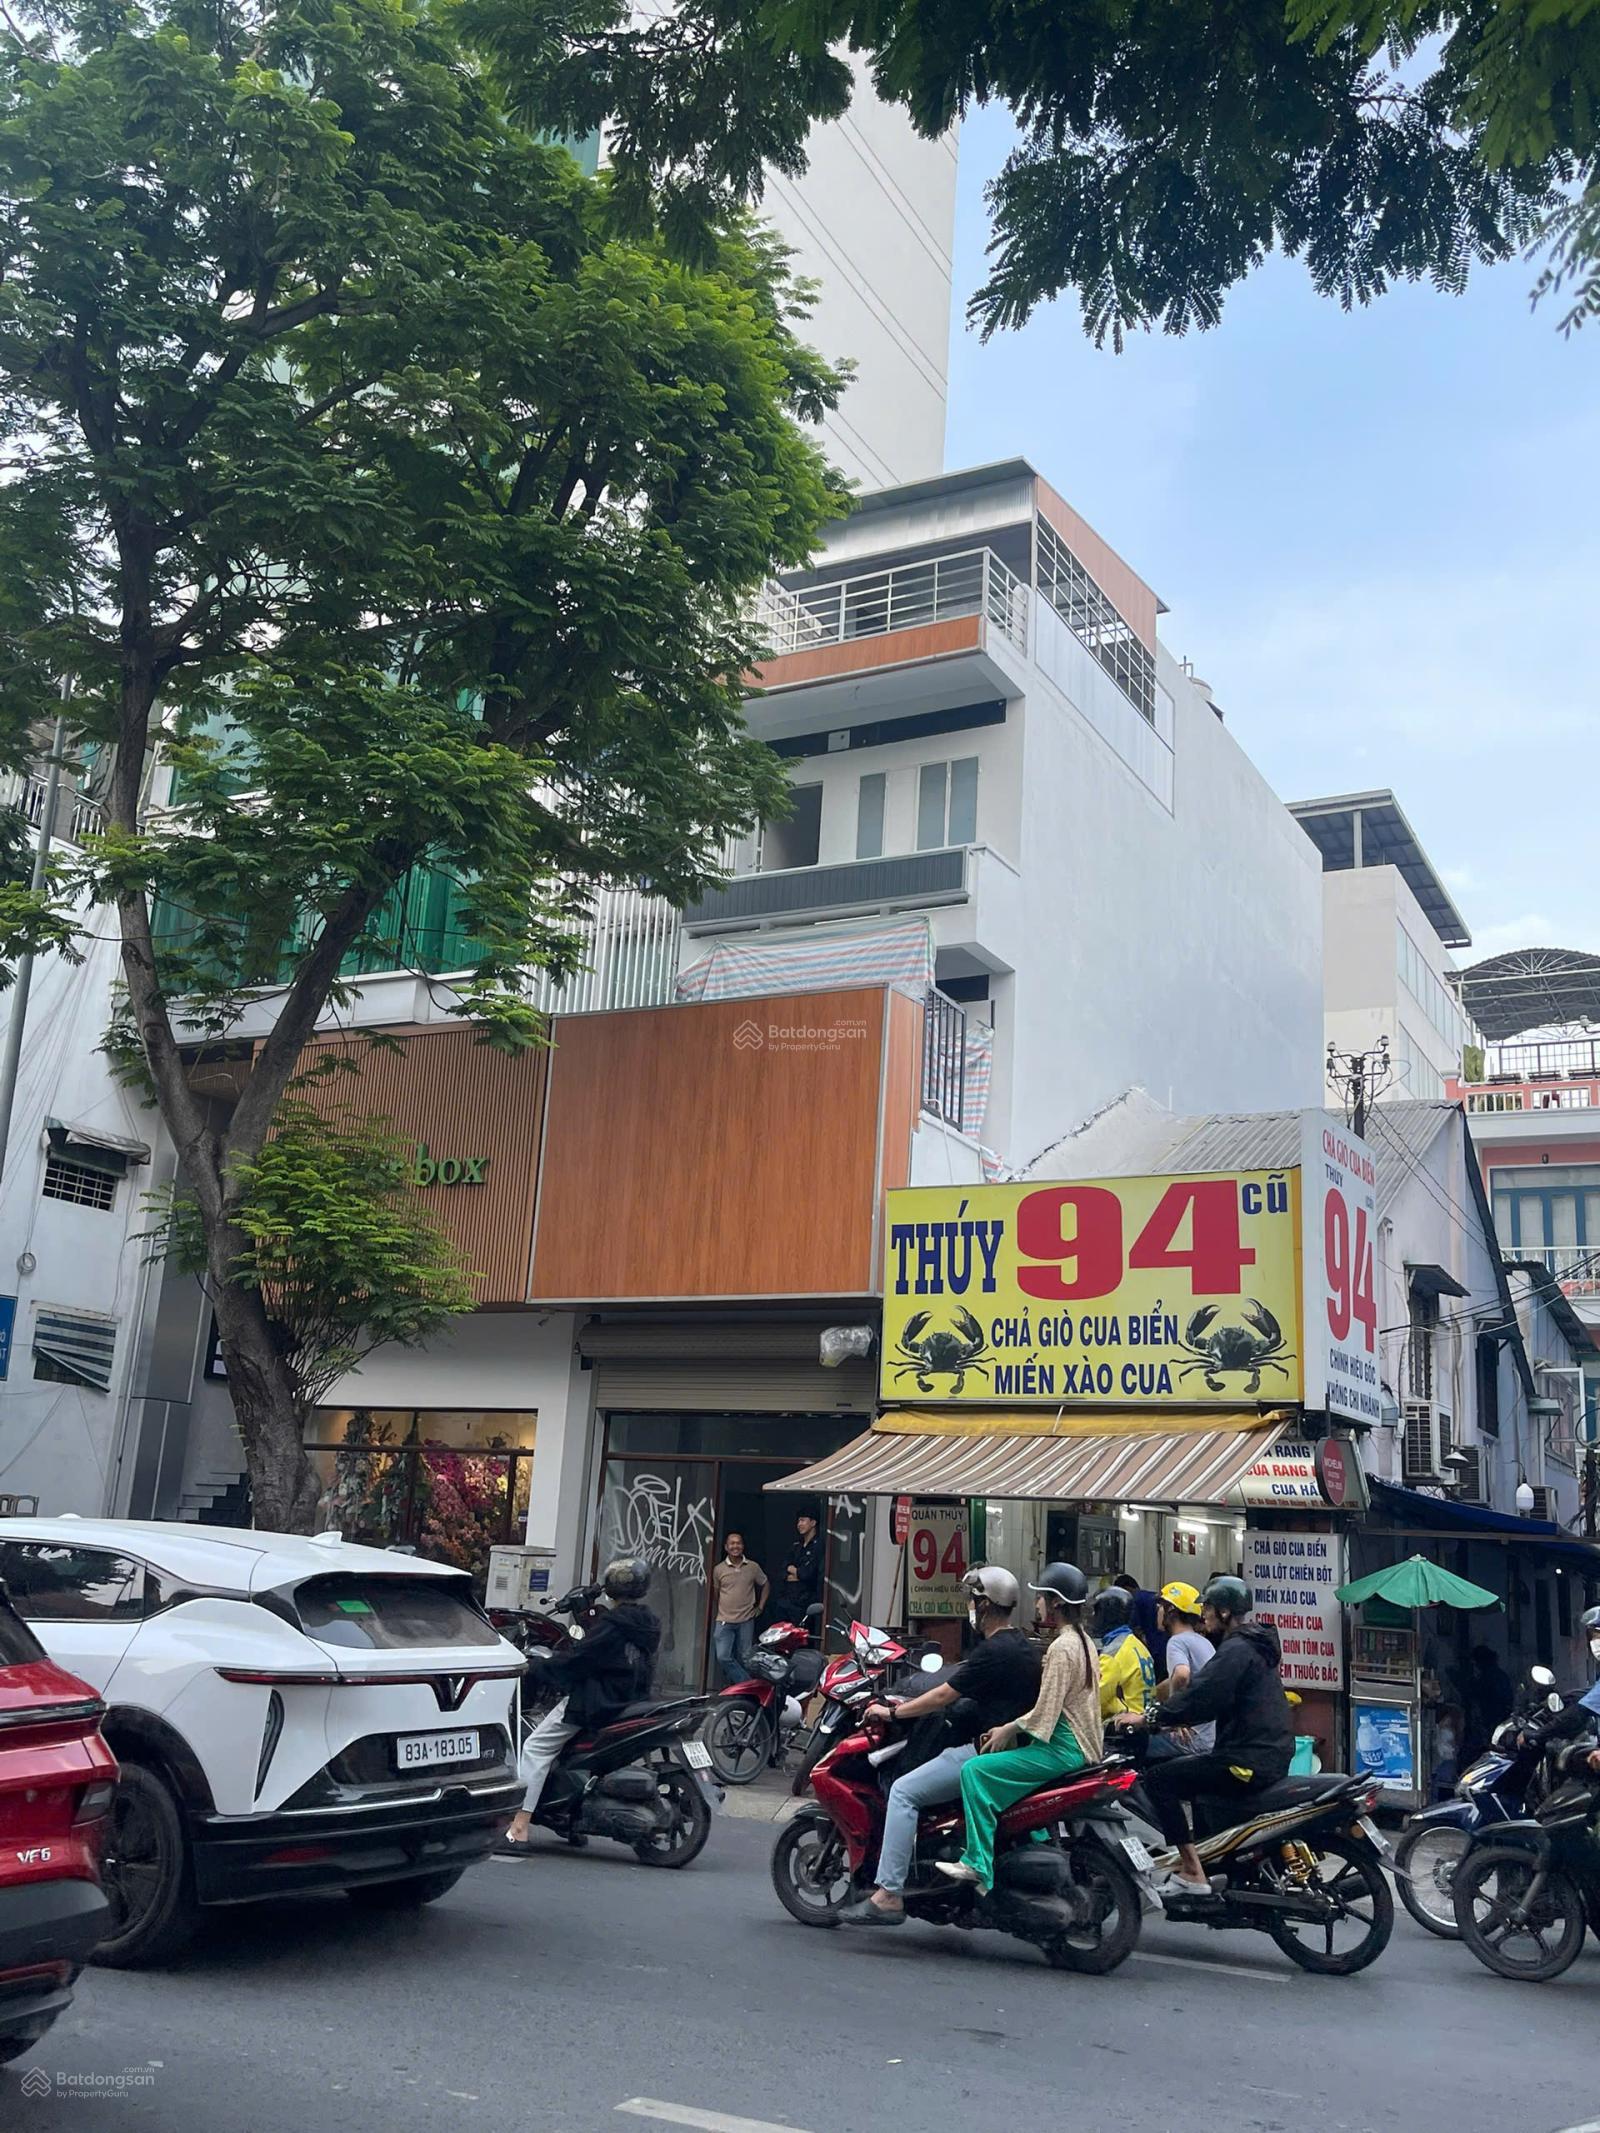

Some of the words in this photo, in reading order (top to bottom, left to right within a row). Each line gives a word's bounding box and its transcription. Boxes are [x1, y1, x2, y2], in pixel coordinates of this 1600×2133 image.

[414, 1144, 487, 1186] box
[891, 1200, 1004, 1295] THÚY
[1017, 1180, 1256, 1300] 94
[1325, 1187, 1377, 1353] 94
[991, 1306, 1032, 1348] CHẢ
[1038, 1309, 1073, 1347] GIÒ
[1079, 1315, 1122, 1346] CUA
[1128, 1299, 1178, 1345] BIỂN
[995, 1353, 1054, 1394] MIẾN
[1063, 1355, 1113, 1394] XÀO
[1121, 1363, 1173, 1394] CUA
[1275, 1446, 1311, 1458] RANG
[1272, 1465, 1308, 1477] RANG
[1272, 1484, 1297, 1495] CUA
[1301, 1480, 1318, 1496] HẤ
[913, 1529, 967, 1583] 94
[1254, 1537, 1271, 1555] CHẢ
[1273, 1538, 1287, 1555] GIÒ
[1289, 1541, 1305, 1556] CUA
[1254, 1564, 1271, 1579] CUA
[1273, 1563, 1288, 1582] LỘT
[1255, 1585, 1277, 1603] MIẾN
[1280, 1587, 1297, 1604] XÀO
[1300, 1591, 1317, 1605] CUA
[1278, 1612, 1304, 1629] CHIÊN
[1306, 1616, 1323, 1630] CUA
[1303, 1638, 1318, 1655] TÔM
[1320, 1641, 1335, 1656] CUA
[1294, 1660, 1320, 1680] THUỐC
